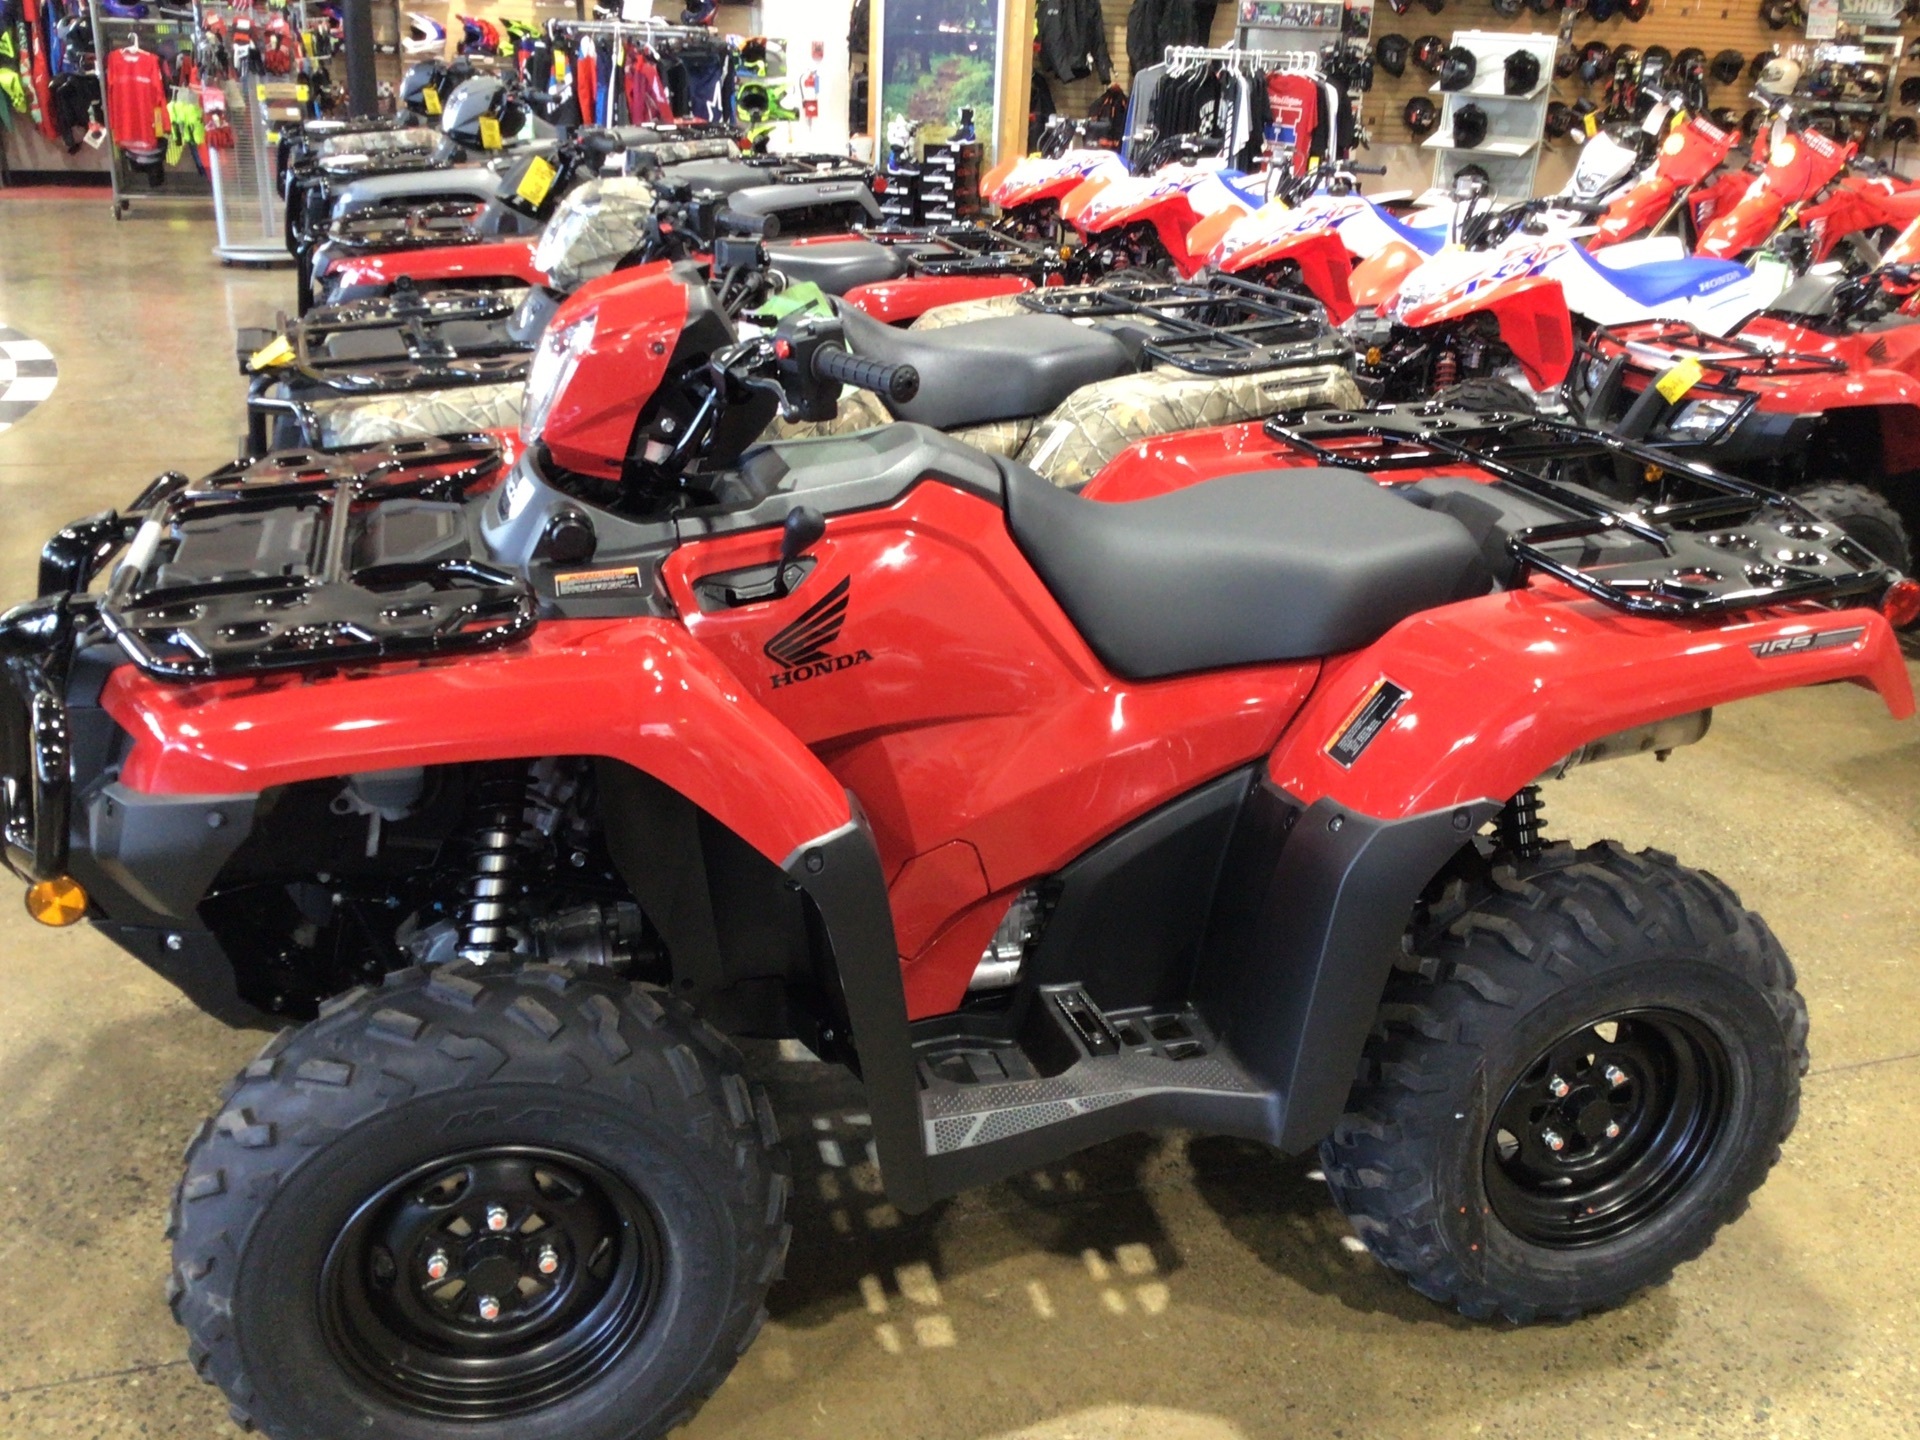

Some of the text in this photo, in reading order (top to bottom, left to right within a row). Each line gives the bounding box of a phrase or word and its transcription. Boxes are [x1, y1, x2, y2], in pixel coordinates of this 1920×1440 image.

[1699, 270, 1741, 293] HONDA
[1761, 635, 1811, 654] IRS
[770, 649, 873, 689] HONDA
